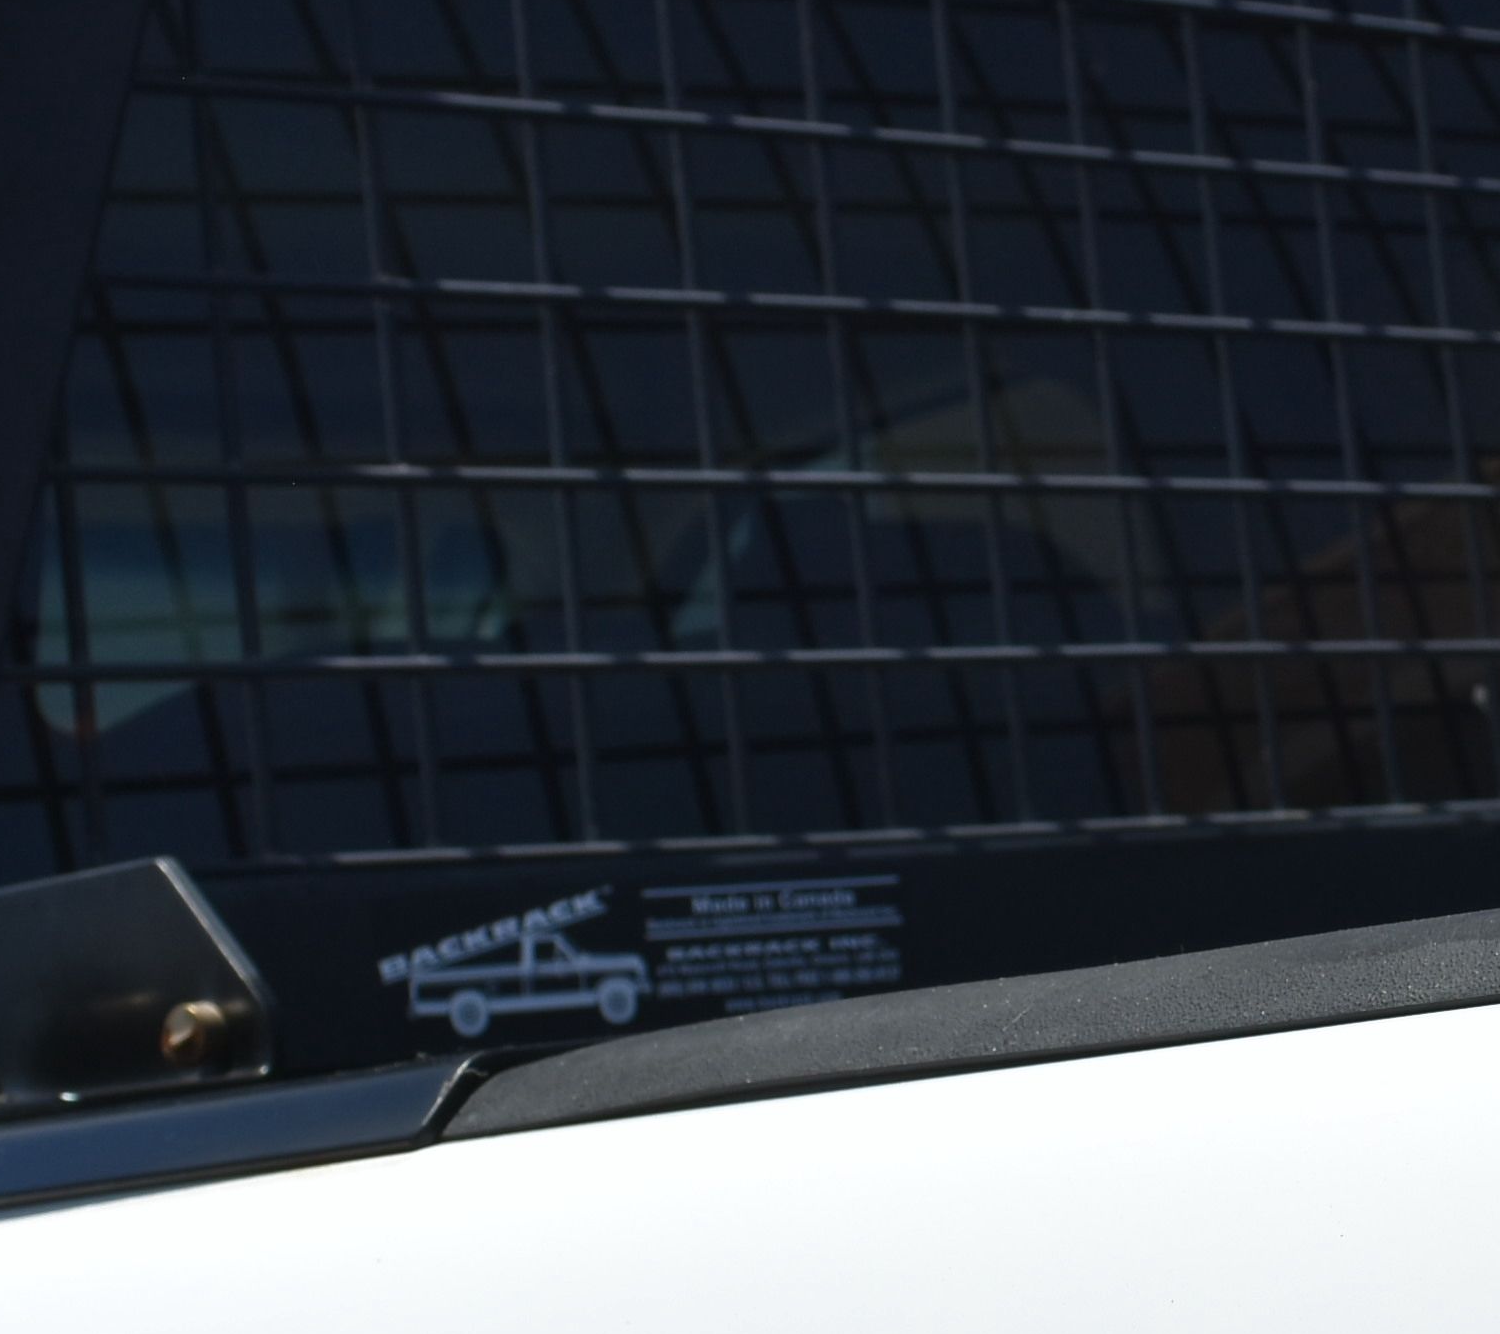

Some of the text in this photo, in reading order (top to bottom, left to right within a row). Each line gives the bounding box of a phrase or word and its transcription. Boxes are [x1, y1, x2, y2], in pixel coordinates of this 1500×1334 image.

[691, 889, 857, 914] Made in Canada
[378, 889, 608, 984] BACKRACK
[665, 937, 821, 961] BACKRACK
